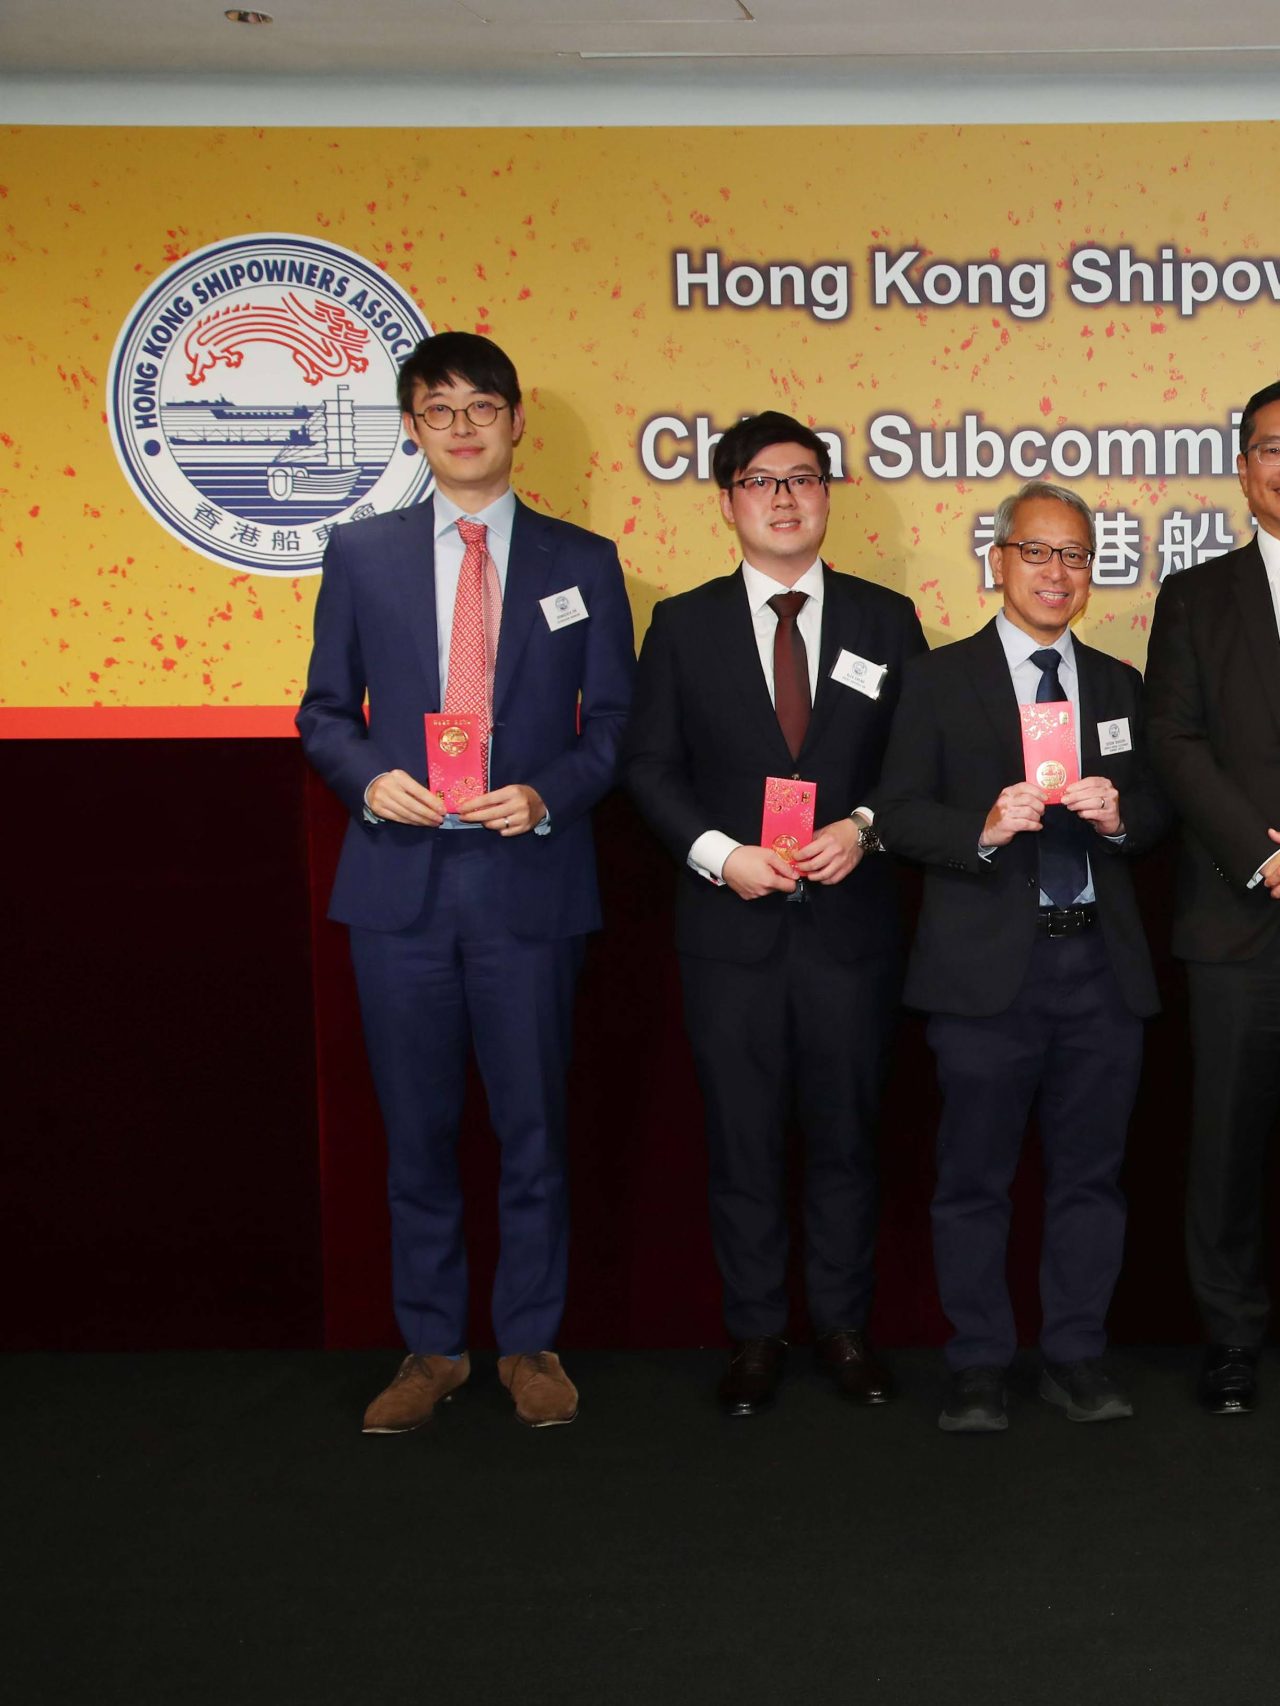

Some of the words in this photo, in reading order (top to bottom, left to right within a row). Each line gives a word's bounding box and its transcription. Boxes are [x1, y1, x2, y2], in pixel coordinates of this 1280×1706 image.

[191, 258, 350, 305] SHIPOWNERS
[676, 253, 848, 320] Hong
[874, 251, 1046, 318] Kong
[142, 296, 194, 360] KONG
[347, 288, 416, 364] ASSOCI
[133, 362, 158, 429] HONG
[641, 416, 845, 480] Cha
